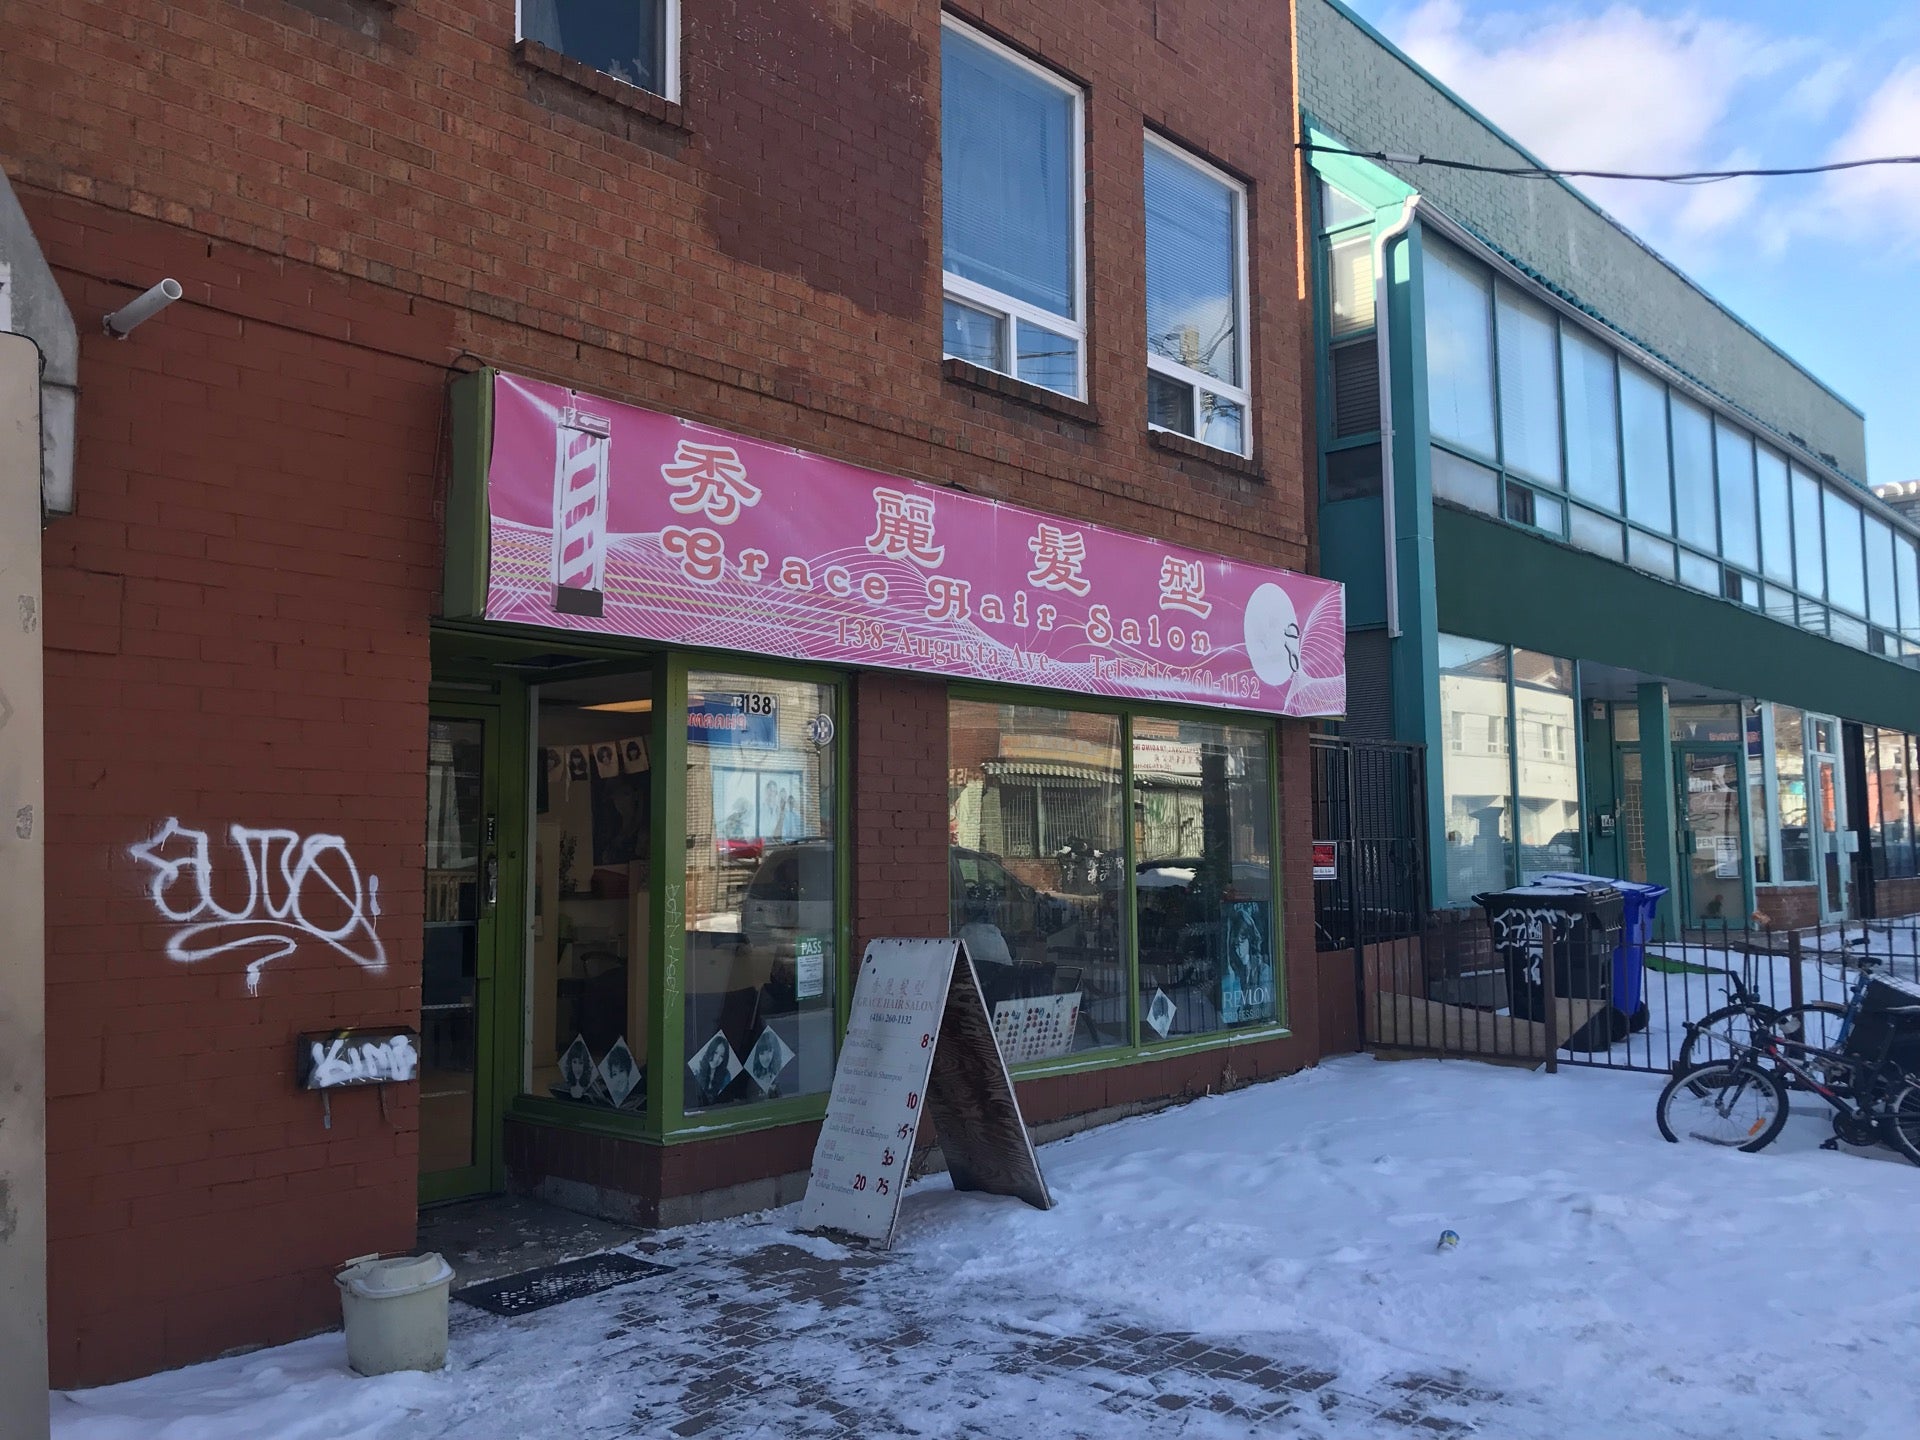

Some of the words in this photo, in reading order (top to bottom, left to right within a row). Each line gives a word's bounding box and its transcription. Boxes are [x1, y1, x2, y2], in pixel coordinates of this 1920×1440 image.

[660, 438, 1213, 620] 秀麗髮型
[659, 526, 889, 604] Grace
[924, 575, 1057, 632] Hair
[1086, 604, 1213, 656] Salon
[835, 616, 885, 651] 138
[893, 625, 1000, 665] Augusta
[1009, 643, 1056, 673] Ave.
[743, 694, 772, 716] 138
[801, 940, 822, 956] PASS
[883, 997, 904, 1010] HAIR
[885, 1013, 912, 1025] 260-1132
[920, 1033, 930, 1049] 8
[906, 1092, 918, 1109] 10
[853, 1172, 867, 1191] 20
